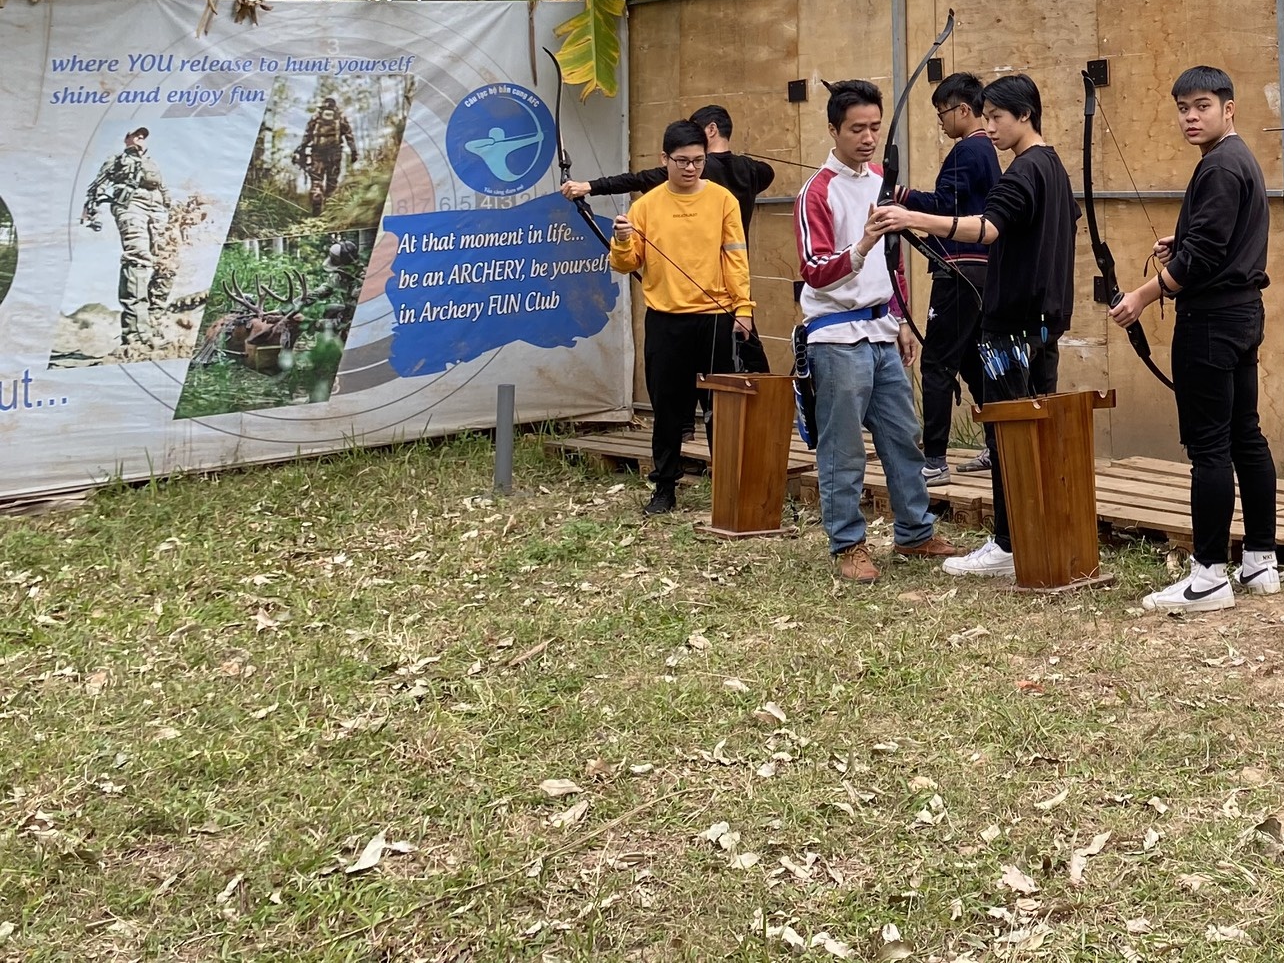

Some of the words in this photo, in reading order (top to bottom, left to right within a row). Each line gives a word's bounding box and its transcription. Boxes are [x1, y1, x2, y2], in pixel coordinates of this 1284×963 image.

[51, 54, 119, 73] where
[127, 53, 174, 73] YOU
[179, 55, 252, 73] release
[259, 56, 279, 73] to
[285, 55, 331, 73] hunt
[334, 55, 416, 76] yourself
[49, 85, 111, 105] shine
[116, 85, 161, 105] and
[166, 85, 224, 107] enjoy
[228, 85, 265, 105] fun
[398, 232, 417, 254] At
[421, 231, 456, 253] that
[459, 228, 525, 250] moment
[527, 224, 543, 244] in
[546, 222, 585, 245] life...
[399, 269, 418, 289] be
[422, 272, 444, 288] an
[447, 257, 527, 285] ARCHERY,
[529, 258, 548, 278] be
[551, 253, 611, 281] yourself
[399, 302, 416, 325] in
[419, 297, 484, 323] Archery
[487, 292, 522, 317] FUN
[525, 290, 561, 313] Club
